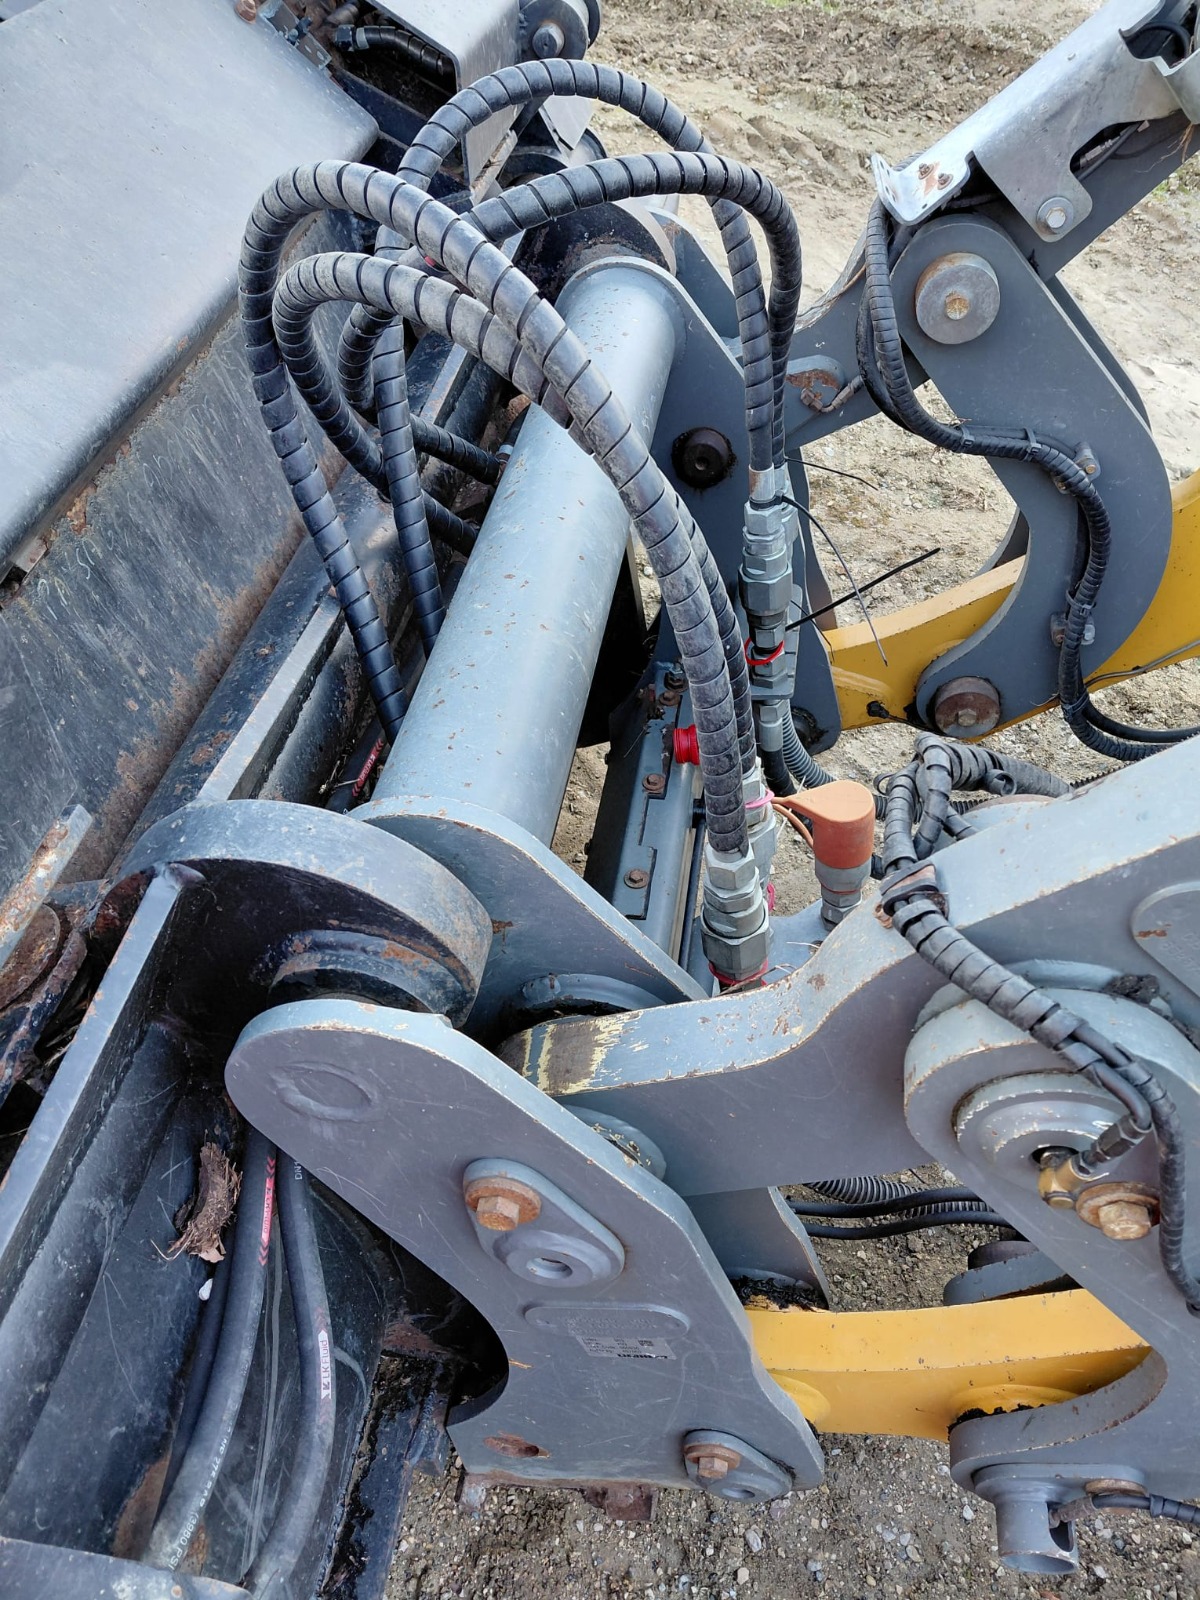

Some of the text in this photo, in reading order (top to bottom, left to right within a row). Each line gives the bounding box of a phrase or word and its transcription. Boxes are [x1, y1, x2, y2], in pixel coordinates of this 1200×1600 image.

[320, 1340, 330, 1379] LK Fluid
[180, 1511, 199, 1545] (3980
[168, 1547, 183, 1570] PSI
